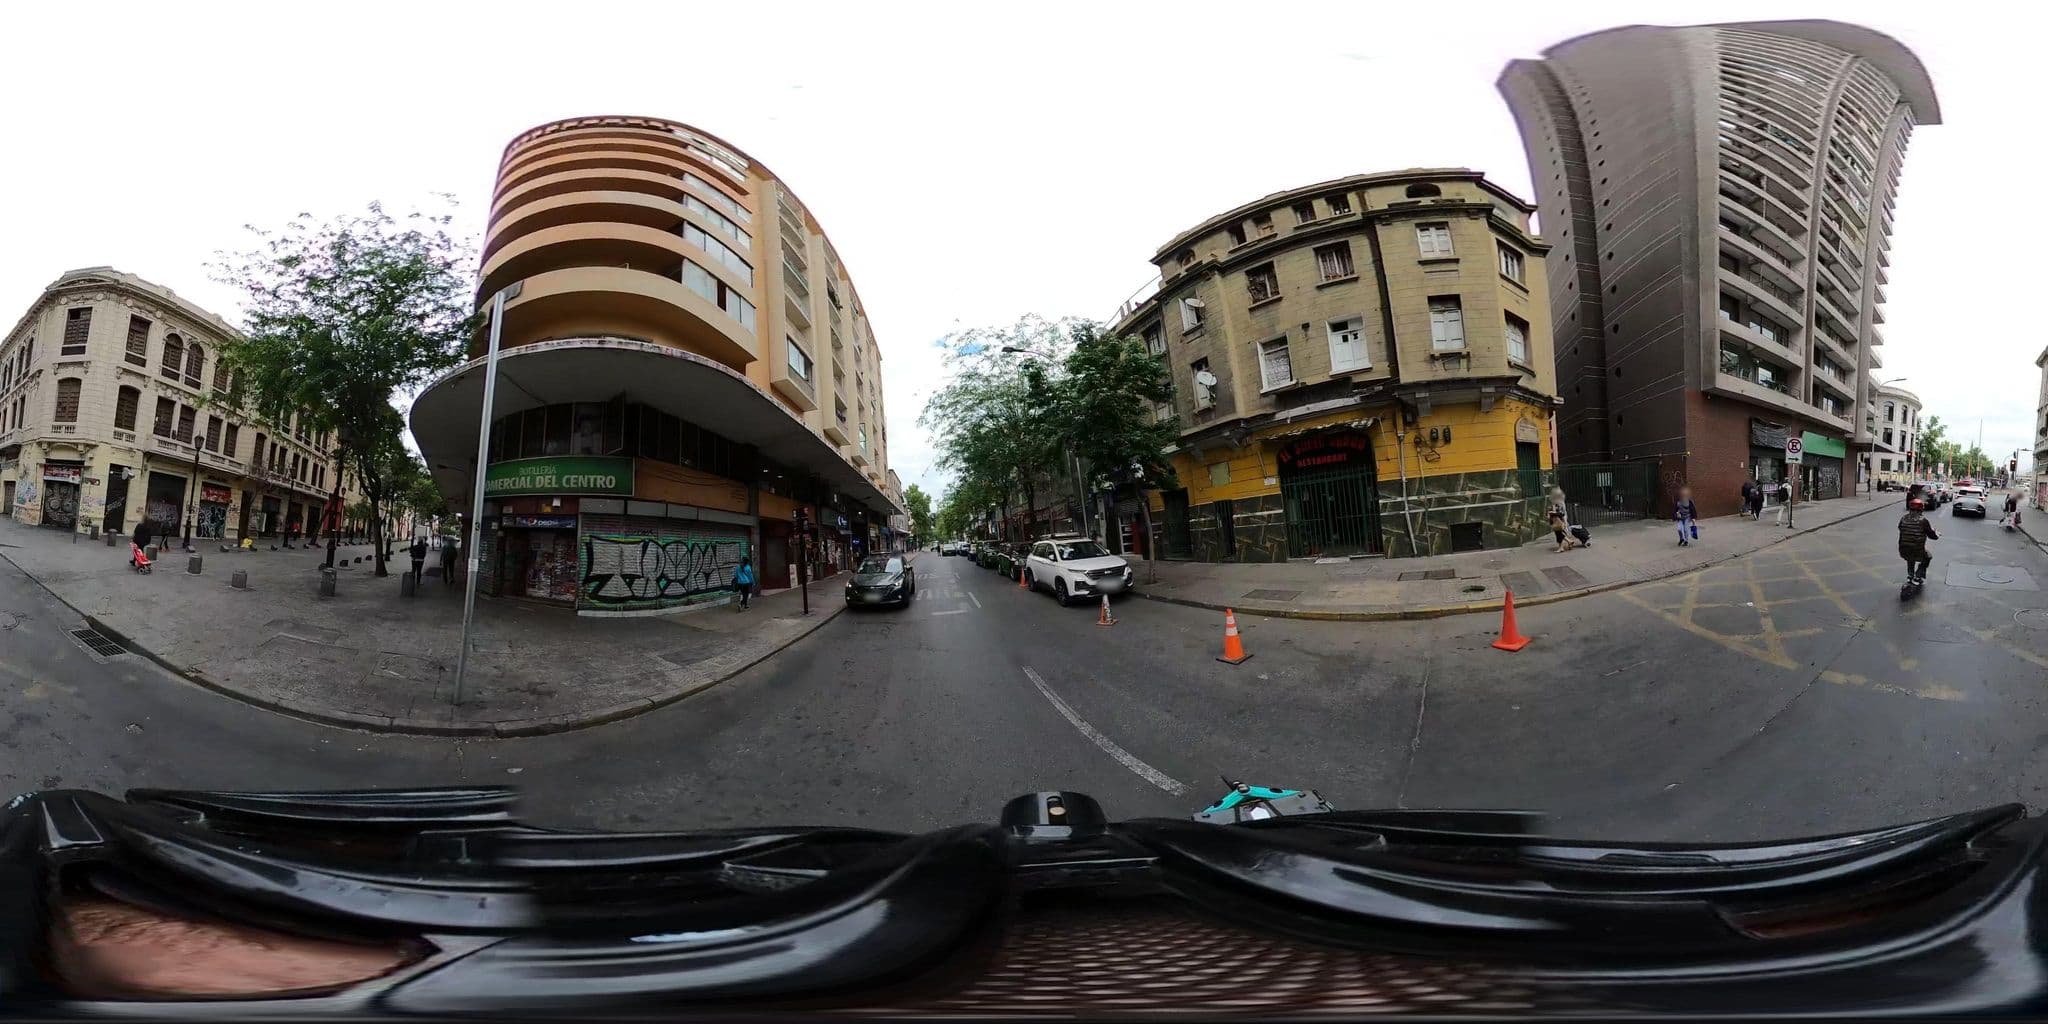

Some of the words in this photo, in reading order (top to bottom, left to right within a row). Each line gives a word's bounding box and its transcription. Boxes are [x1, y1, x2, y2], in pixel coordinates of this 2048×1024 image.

[485, 476, 532, 491] OMERCIAL
[535, 475, 559, 488] DEL
[562, 474, 616, 488] CENTRO
